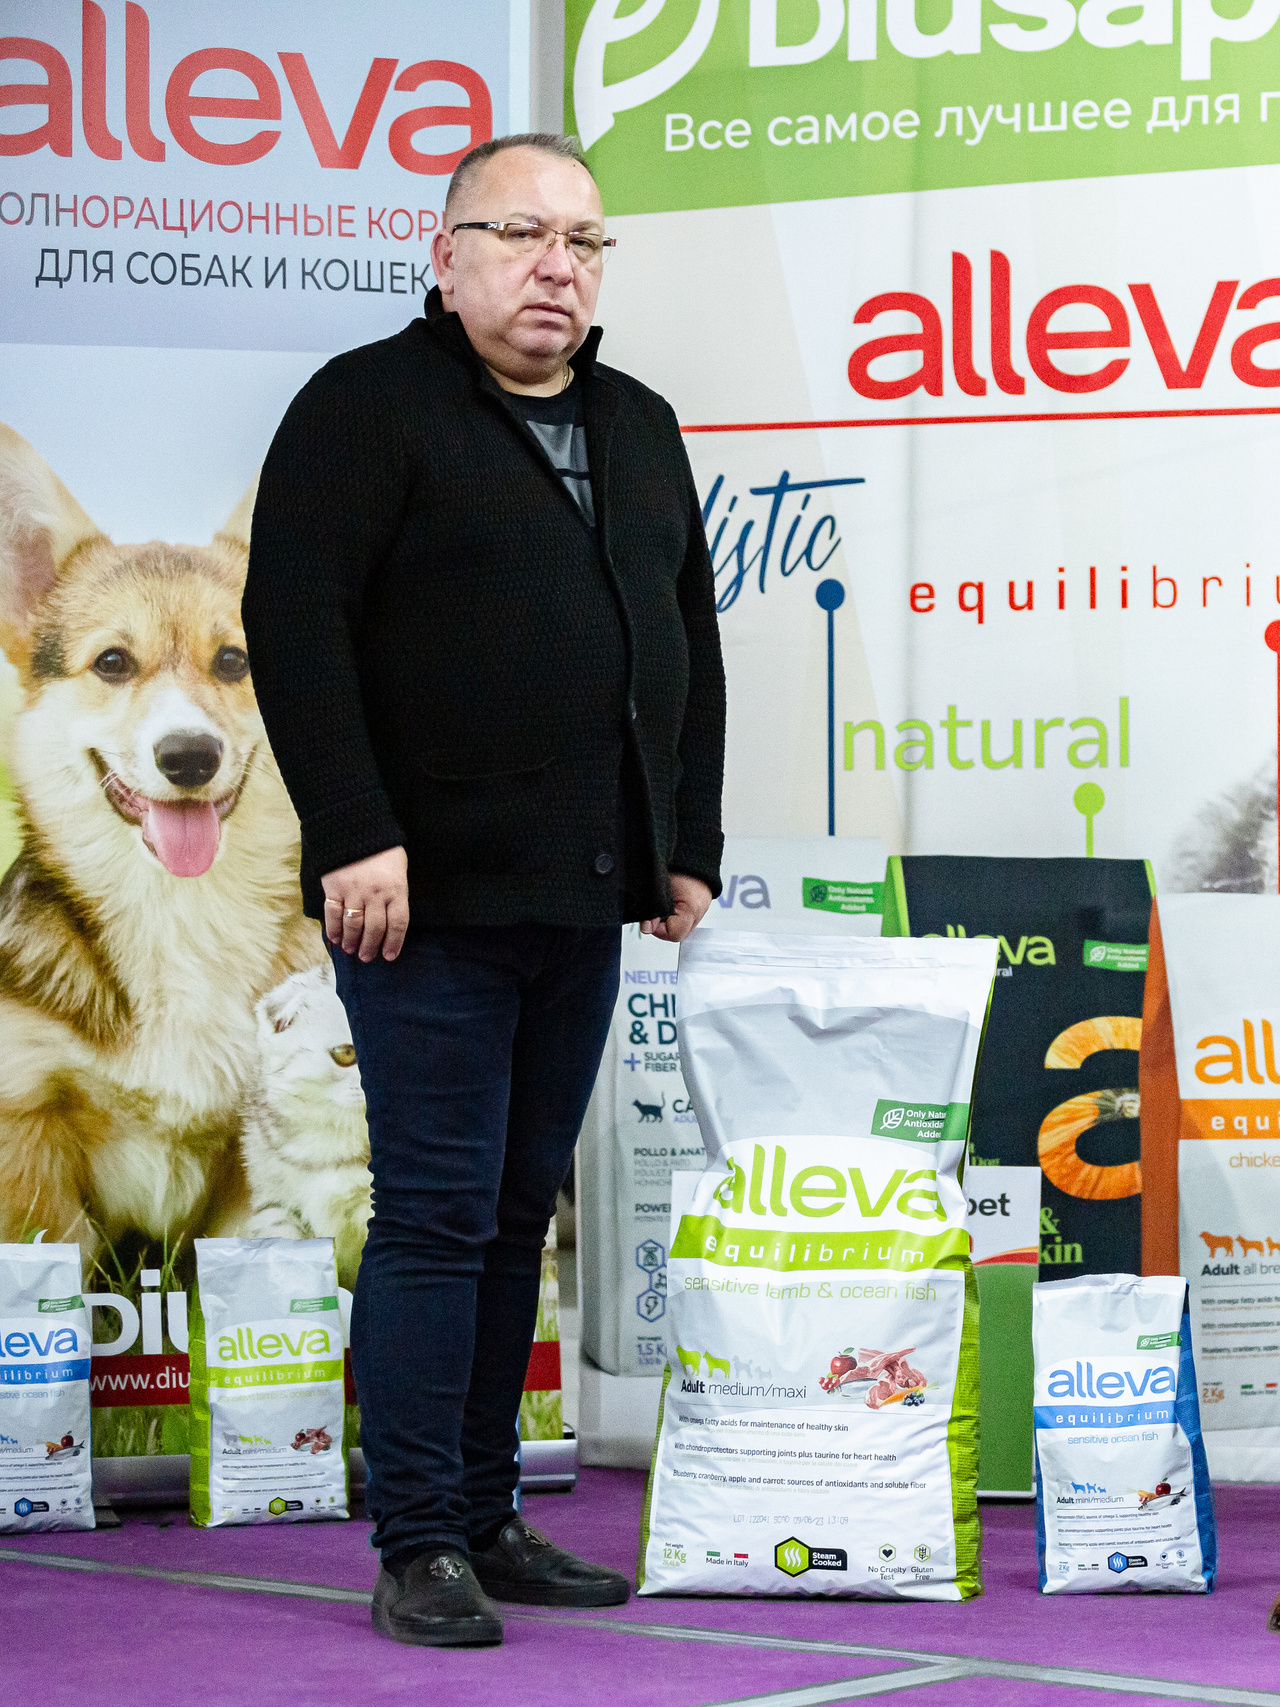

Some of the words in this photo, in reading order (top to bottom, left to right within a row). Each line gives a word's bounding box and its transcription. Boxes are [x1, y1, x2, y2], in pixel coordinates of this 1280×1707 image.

[0, 0, 493, 176] alleva
[664, 111, 752, 152] Все
[768, 108, 920, 147] самое
[934, 98, 1132, 146] лучшее
[1146, 93, 1240, 134] для
[35, 248, 113, 288] ДЛЯ
[126, 251, 252, 289] СОБАК
[264, 257, 289, 291] И
[301, 257, 431, 295] КОШЕК
[843, 696, 1130, 771] natural
[628, 1020, 649, 1045] &
[644, 1063, 677, 1072] FIBER
[906, 1109, 926, 1119] Only
[713, 1144, 947, 1222] alleva
[705, 1234, 925, 1264] equilibrium
[1201, 1264, 1240, 1276] Adult
[1243, 1263, 1257, 1275] all
[684, 1276, 759, 1295] sensitive
[766, 1281, 811, 1300] lamb
[817, 1282, 834, 1299] &
[840, 1284, 898, 1299] ocean
[905, 1282, 937, 1301] fish
[218, 1326, 331, 1362] alleva
[224, 1367, 326, 1386] equilibrium
[1048, 1361, 1176, 1399] alleva
[680, 1379, 705, 1394] Adult
[708, 1380, 807, 1399] medium/maxi
[705, 1417, 720, 1427] fatty
[720, 1419, 738, 1427] acids
[739, 1419, 749, 1427] for
[750, 1420, 796, 1430] maintenance
[797, 1422, 805, 1430] of
[806, 1422, 833, 1432] healthy
[834, 1423, 849, 1432] skin
[1056, 1409, 1169, 1425] equilibrium
[1068, 1434, 1109, 1445] sensitive
[1111, 1434, 1140, 1444] ocean
[1141, 1431, 1159, 1441] fish
[222, 1447, 241, 1455] Adult
[685, 1443, 739, 1455] chondroprotectors
[739, 1447, 777, 1458] supporting
[777, 1448, 797, 1458] joints
[798, 1450, 813, 1459] plus
[814, 1451, 840, 1460] taurine
[841, 1451, 852, 1460] for
[853, 1452, 873, 1461] heart
[873, 1453, 897, 1461] health
[698, 1472, 728, 1483] cranberry,
[728, 1475, 747, 1484] apple
[748, 1476, 762, 1485] and
[762, 1477, 786, 1486] carrot:
[786, 1478, 815, 1487] sources
[815, 1479, 824, 1487] of
[824, 1480, 869, 1489] antioxidants
[869, 1481, 884, 1489] and
[884, 1481, 909, 1489] soluble
[910, 1481, 927, 1489] fiber
[1056, 1496, 1075, 1504] Adult
[1076, 1495, 1124, 1504] mini/medium
[663, 1548, 672, 1559] 12
[674, 1549, 687, 1564] Kg
[706, 1557, 725, 1565] Made
[725, 1558, 733, 1566] in
[733, 1559, 749, 1568] Italy
[812, 1551, 837, 1560] Steam
[812, 1559, 842, 1567] Cooked
[880, 1566, 907, 1575] Cruelty
